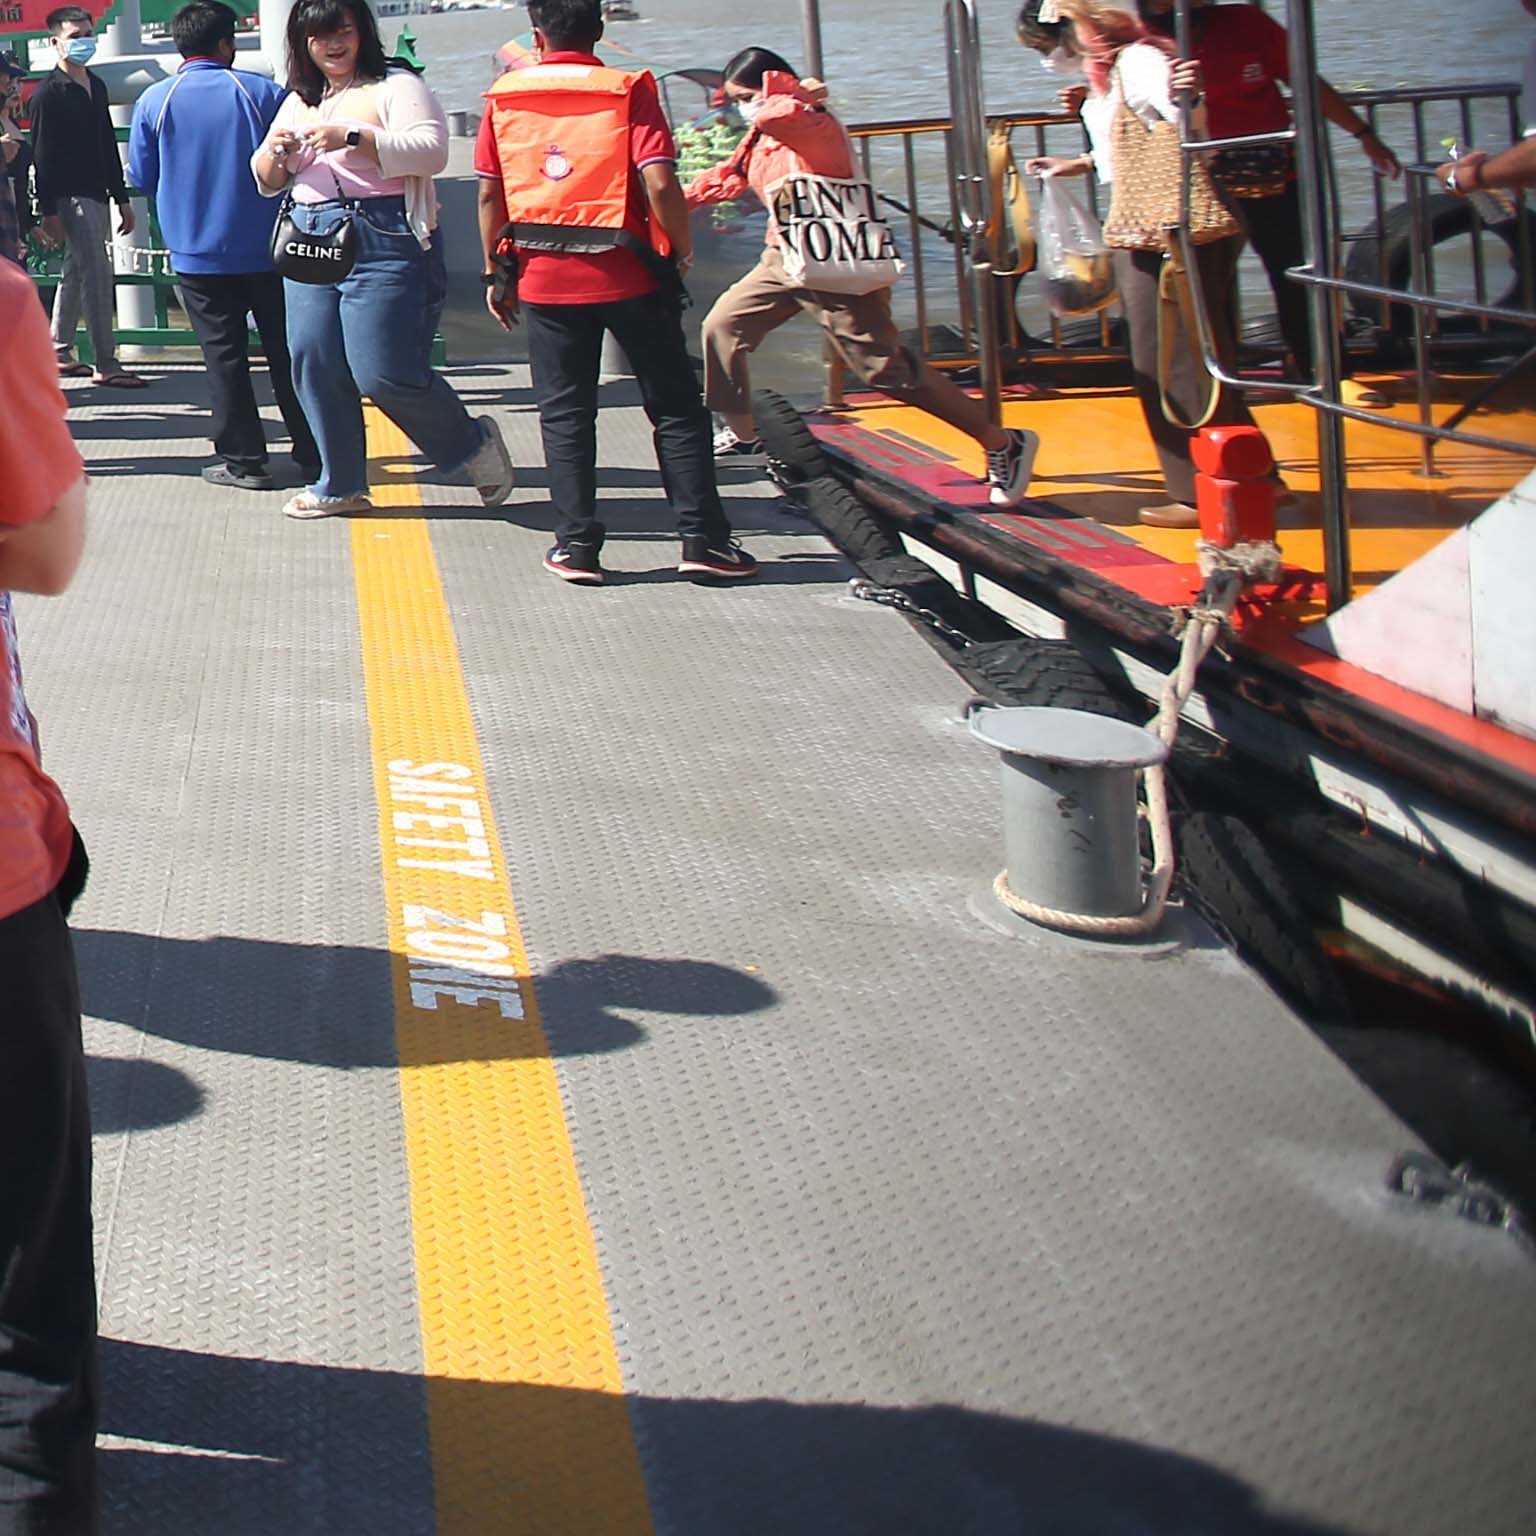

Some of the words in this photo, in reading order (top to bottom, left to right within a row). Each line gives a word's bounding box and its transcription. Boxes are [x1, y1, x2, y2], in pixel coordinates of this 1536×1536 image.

[285, 242, 342, 261] CELINE
[388, 758, 496, 881] SAFETY
[402, 903, 525, 1020] ZONE
